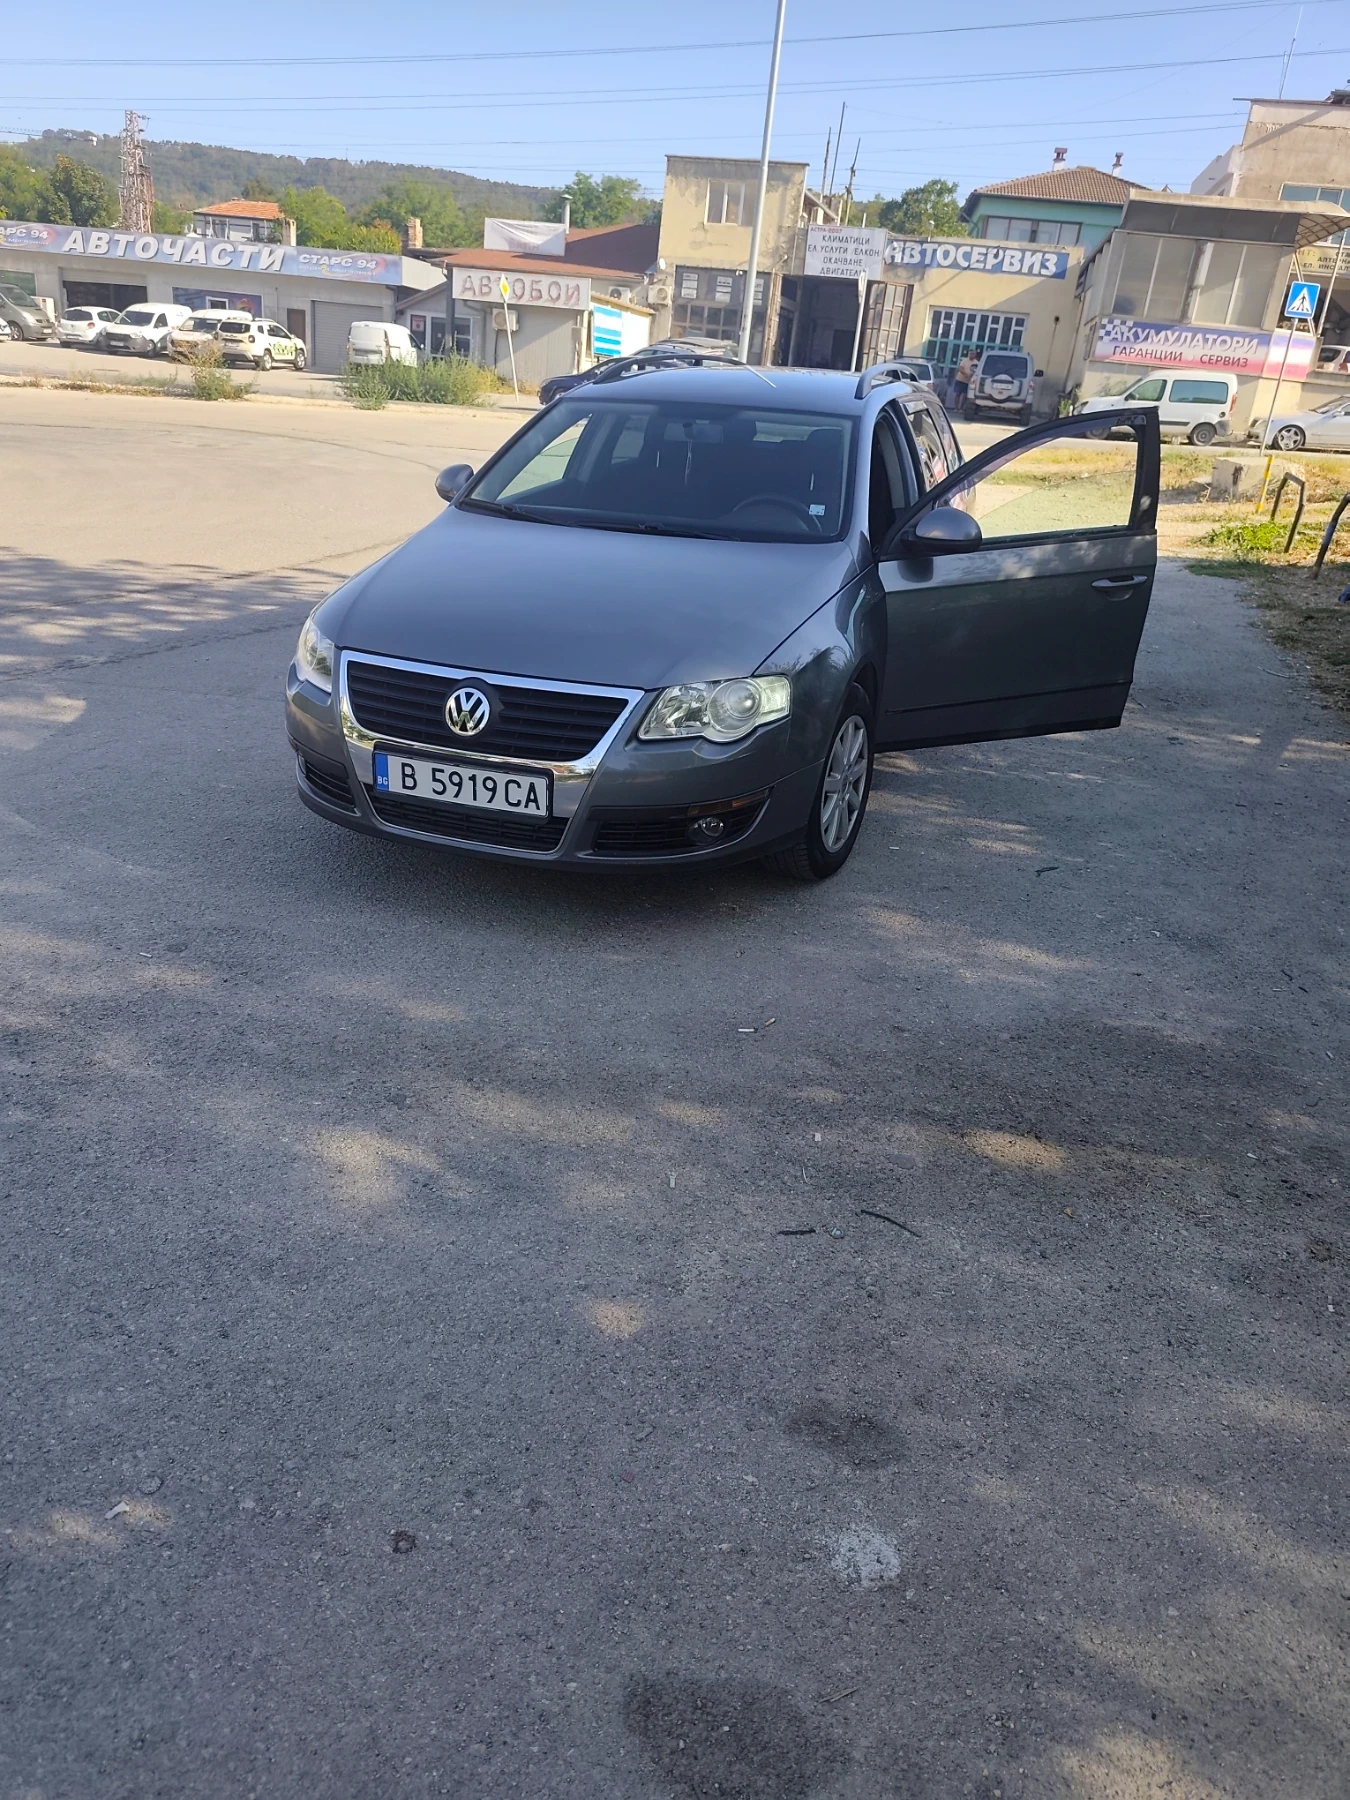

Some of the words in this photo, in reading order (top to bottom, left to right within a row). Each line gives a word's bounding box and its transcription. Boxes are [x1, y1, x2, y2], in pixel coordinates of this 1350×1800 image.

[30, 229, 49, 239] 94
[822, 235, 870, 246] КЛИМАТИЦИ
[62, 230, 285, 271] АВТОЧАСТИ
[820, 245, 848, 255] УСЛУГИ
[299, 254, 353, 267] СТАРС
[357, 260, 377, 270] 94
[823, 257, 863, 267] ОКАЧВАНЕ
[884, 241, 1058, 276] АВТОСЕРВИЗ
[1109, 325, 1258, 355] АКУМУЛАТОРИ
[1113, 345, 1183, 362] ГАРАНЦИИ
[1200, 354, 1249, 368] СЕРВИЗ
[377, 775, 388, 785] BG
